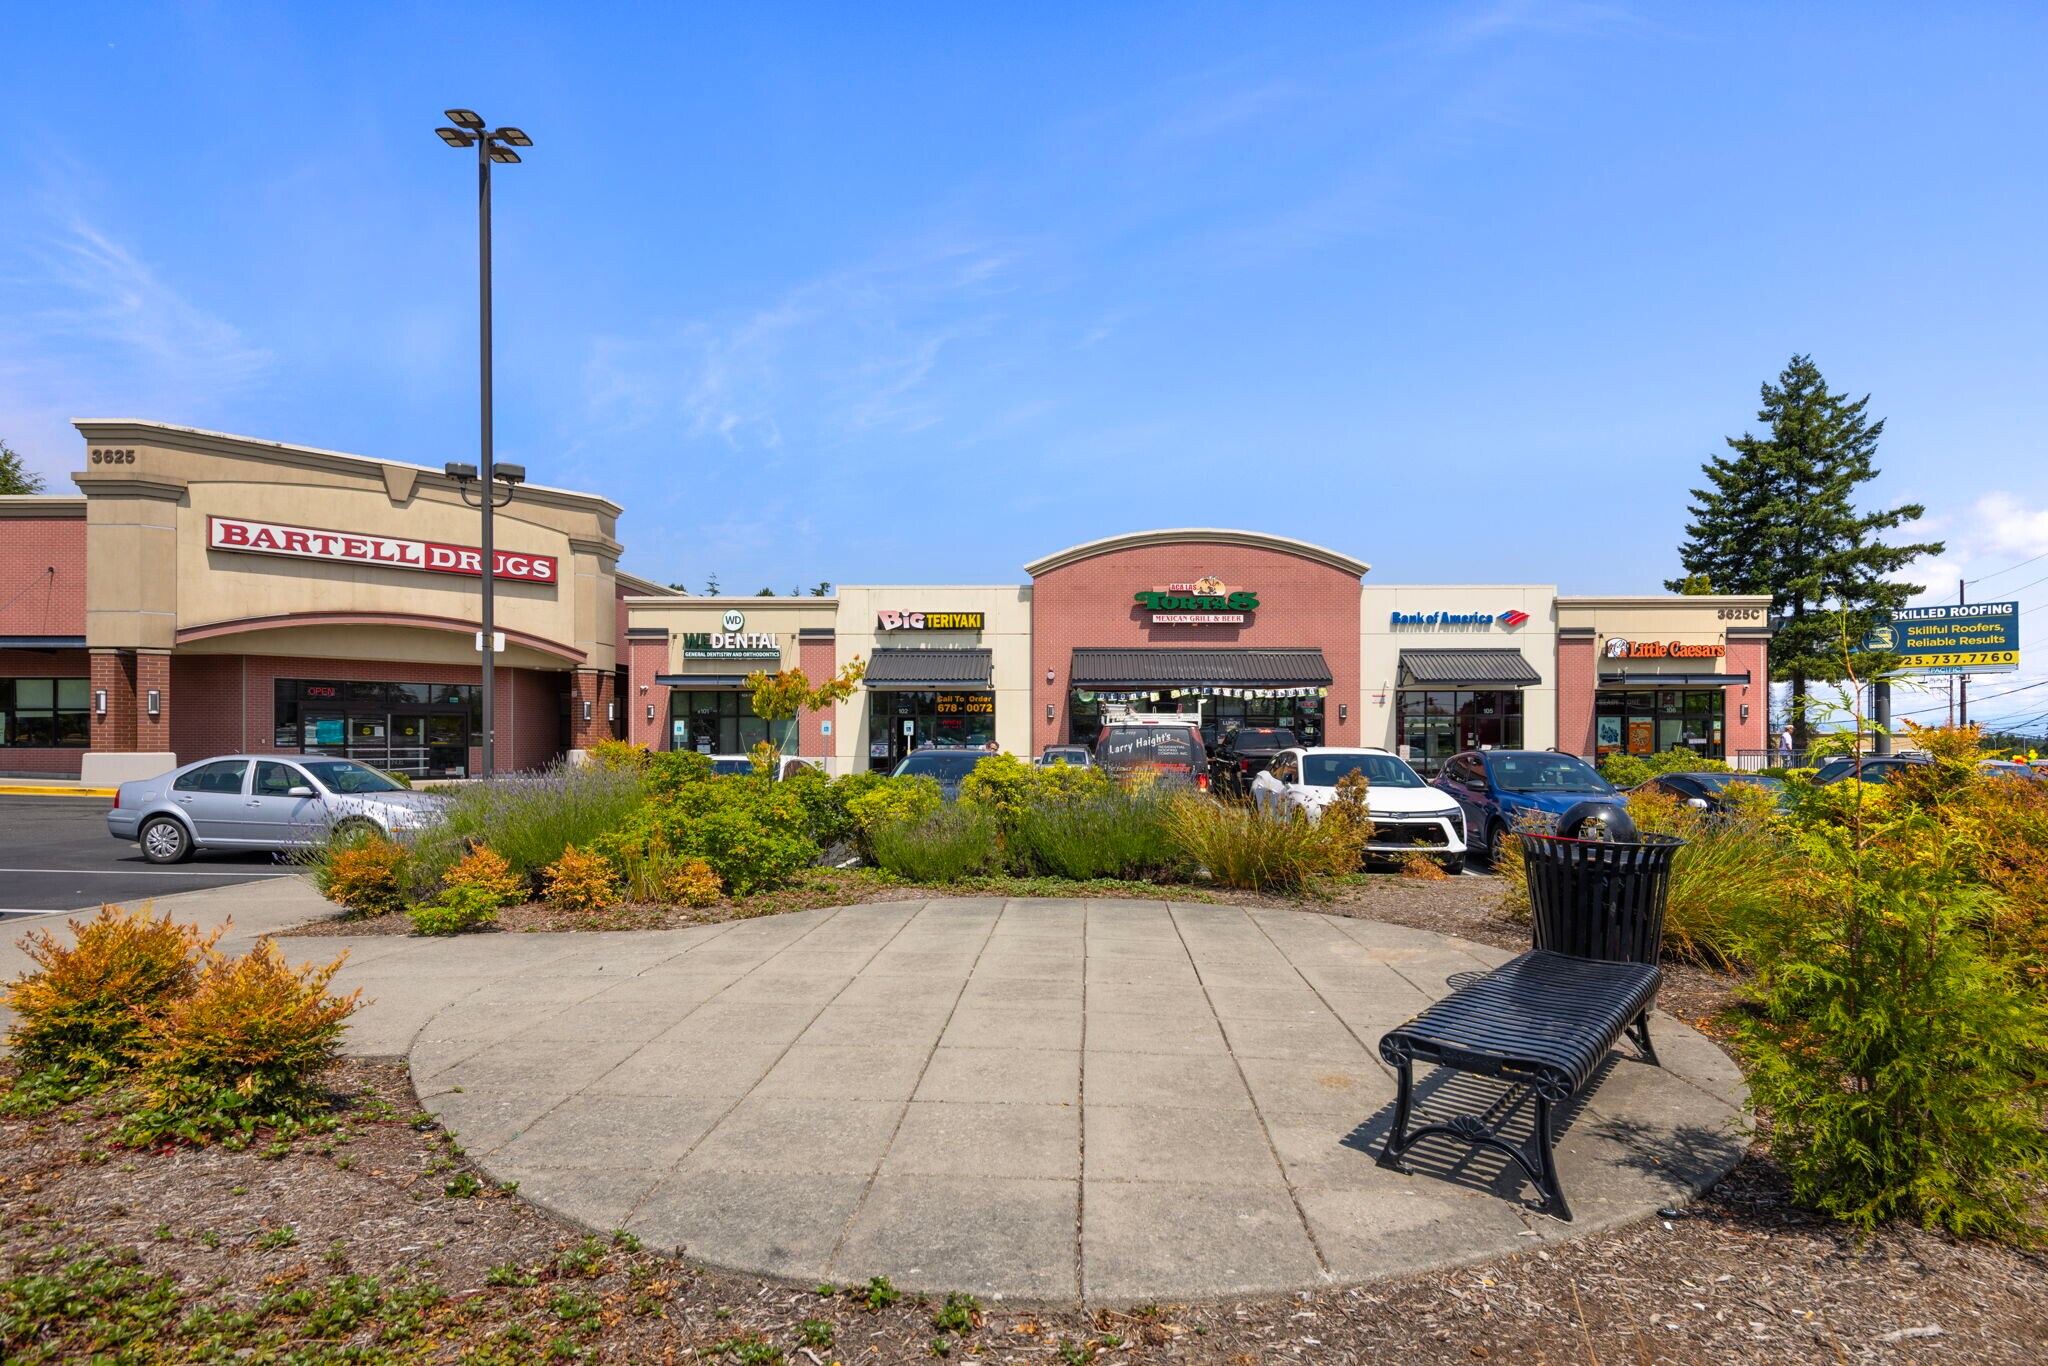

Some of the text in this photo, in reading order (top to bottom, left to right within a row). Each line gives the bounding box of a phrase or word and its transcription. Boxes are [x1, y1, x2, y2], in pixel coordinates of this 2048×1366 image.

[92, 449, 136, 465] 3625
[219, 523, 421, 565] BARTELL
[1134, 591, 1261, 611] TORTAS
[1392, 611, 1494, 624] Bank of America
[1717, 609, 1760, 620] 3625C
[1892, 604, 2013, 621] SKILLED ROOFING
[725, 615, 742, 625] WD
[926, 613, 981, 628] TERIYAKI
[1907, 622, 2004, 636] Skillful Roofers,
[1907, 634, 2006, 648] Reliable Results
[1629, 641, 1726, 657] Little Caesars
[1902, 652, 2014, 666] 25.737.7760
[307, 687, 336, 696] OPEN
[1109, 743, 1133, 754] Larry
[1136, 733, 1171, 748] Haight's
